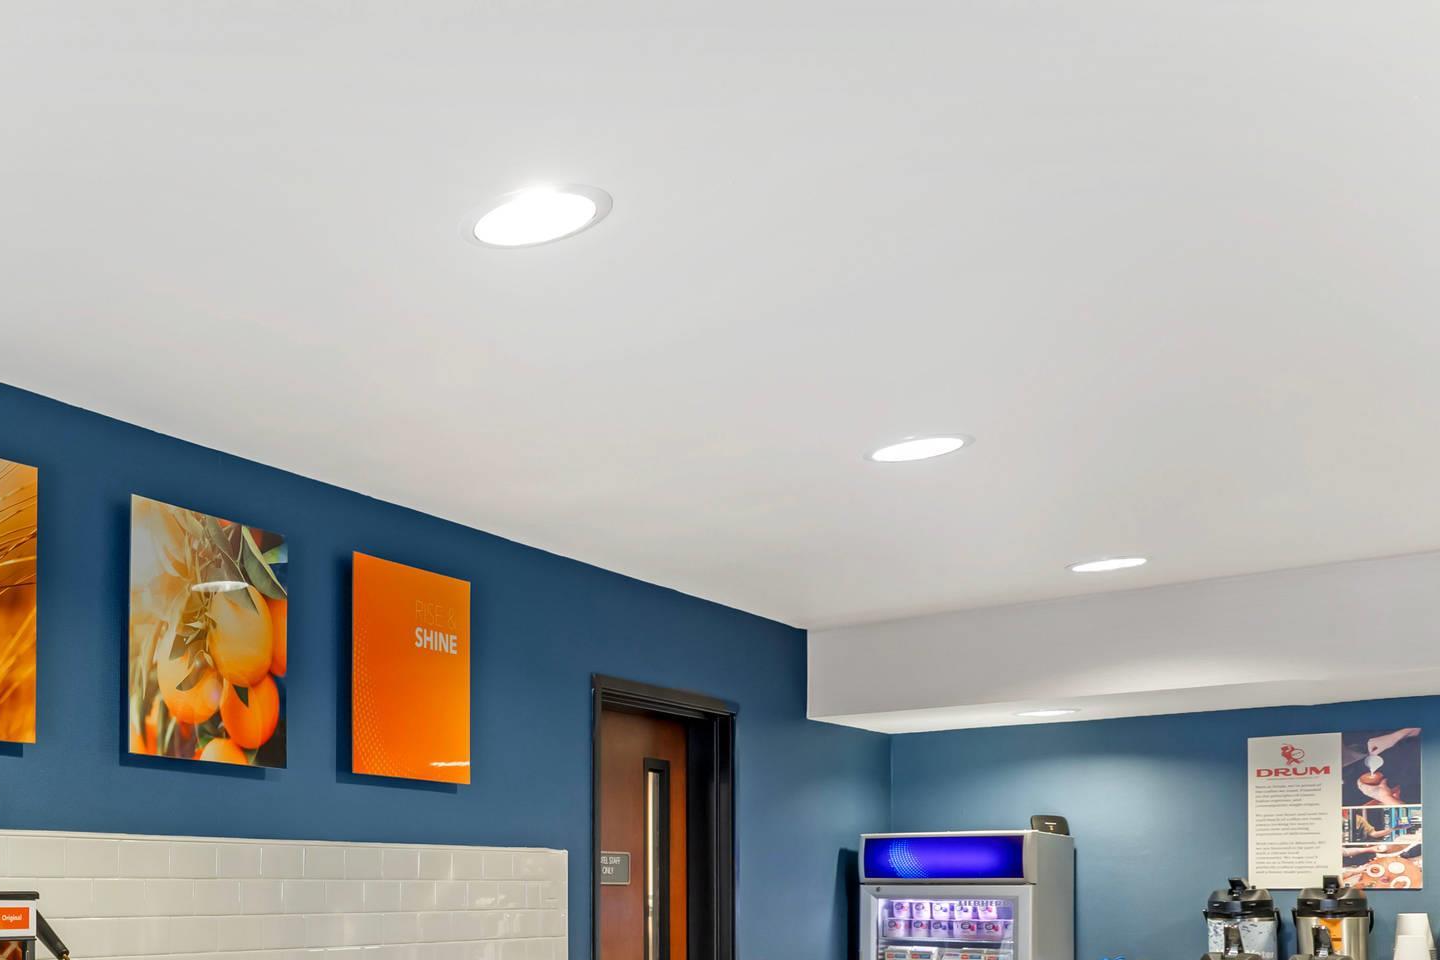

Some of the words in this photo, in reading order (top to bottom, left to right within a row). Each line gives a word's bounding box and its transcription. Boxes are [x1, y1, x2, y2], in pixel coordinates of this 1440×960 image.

[415, 626, 457, 654] SHINE
[1255, 765, 1331, 778] DRUM
[1, 914, 23, 923] Original
